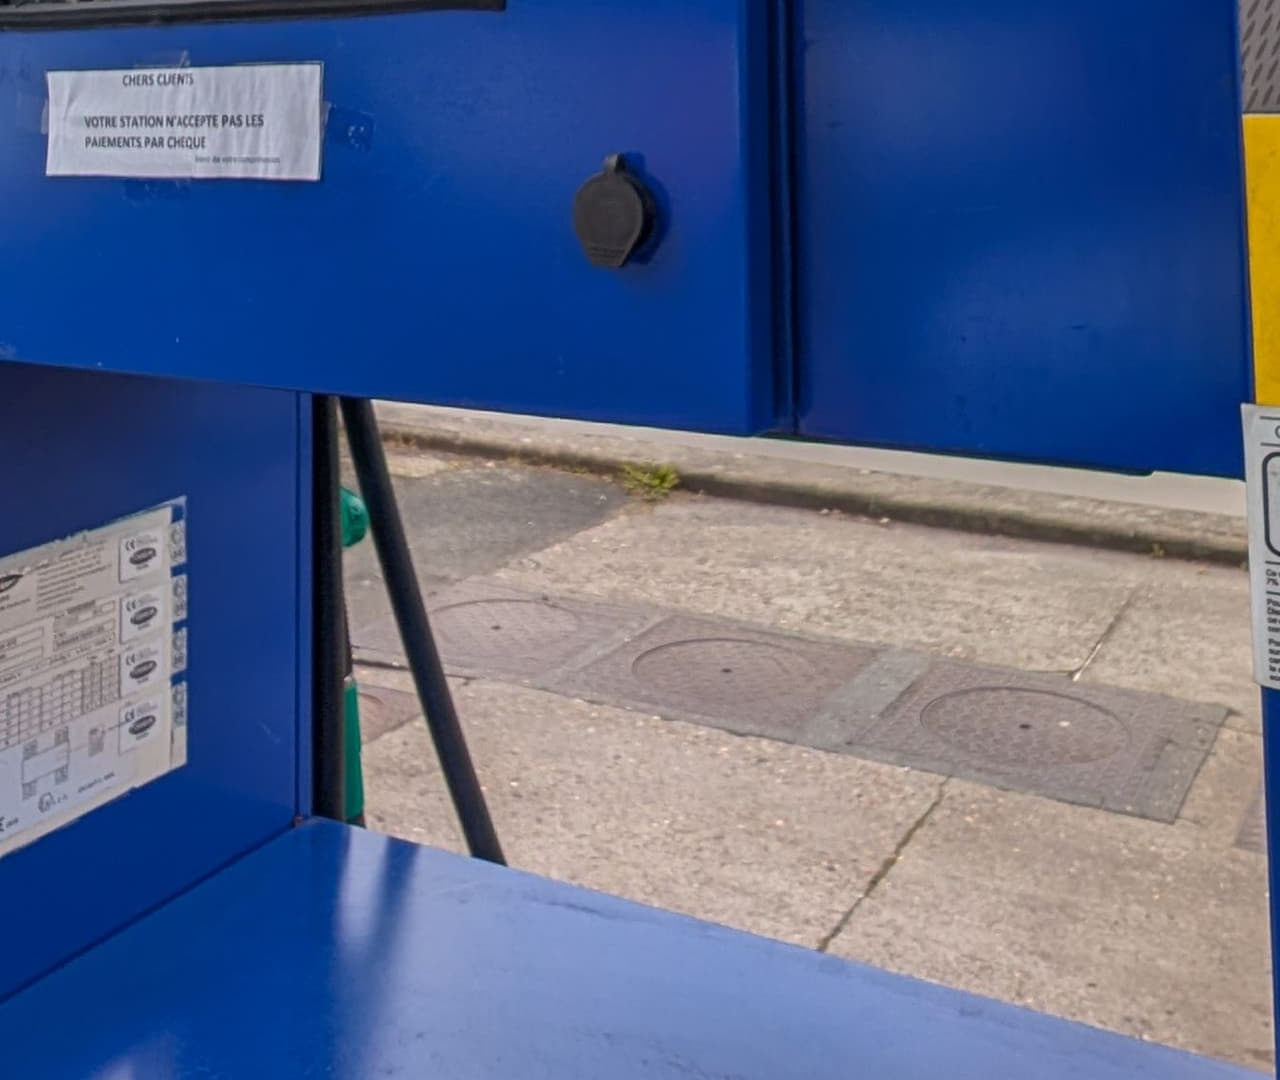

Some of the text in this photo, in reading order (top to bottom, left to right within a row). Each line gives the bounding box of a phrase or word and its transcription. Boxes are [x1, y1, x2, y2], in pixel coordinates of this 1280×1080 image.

[123, 73, 154, 87] CHERS
[84, 115, 117, 129] VOTRE
[119, 115, 164, 129] STATION
[222, 113, 243, 128] PAS
[246, 113, 265, 128] LES
[84, 135, 142, 150] PAIEMENTS
[144, 135, 165, 150] PAR
